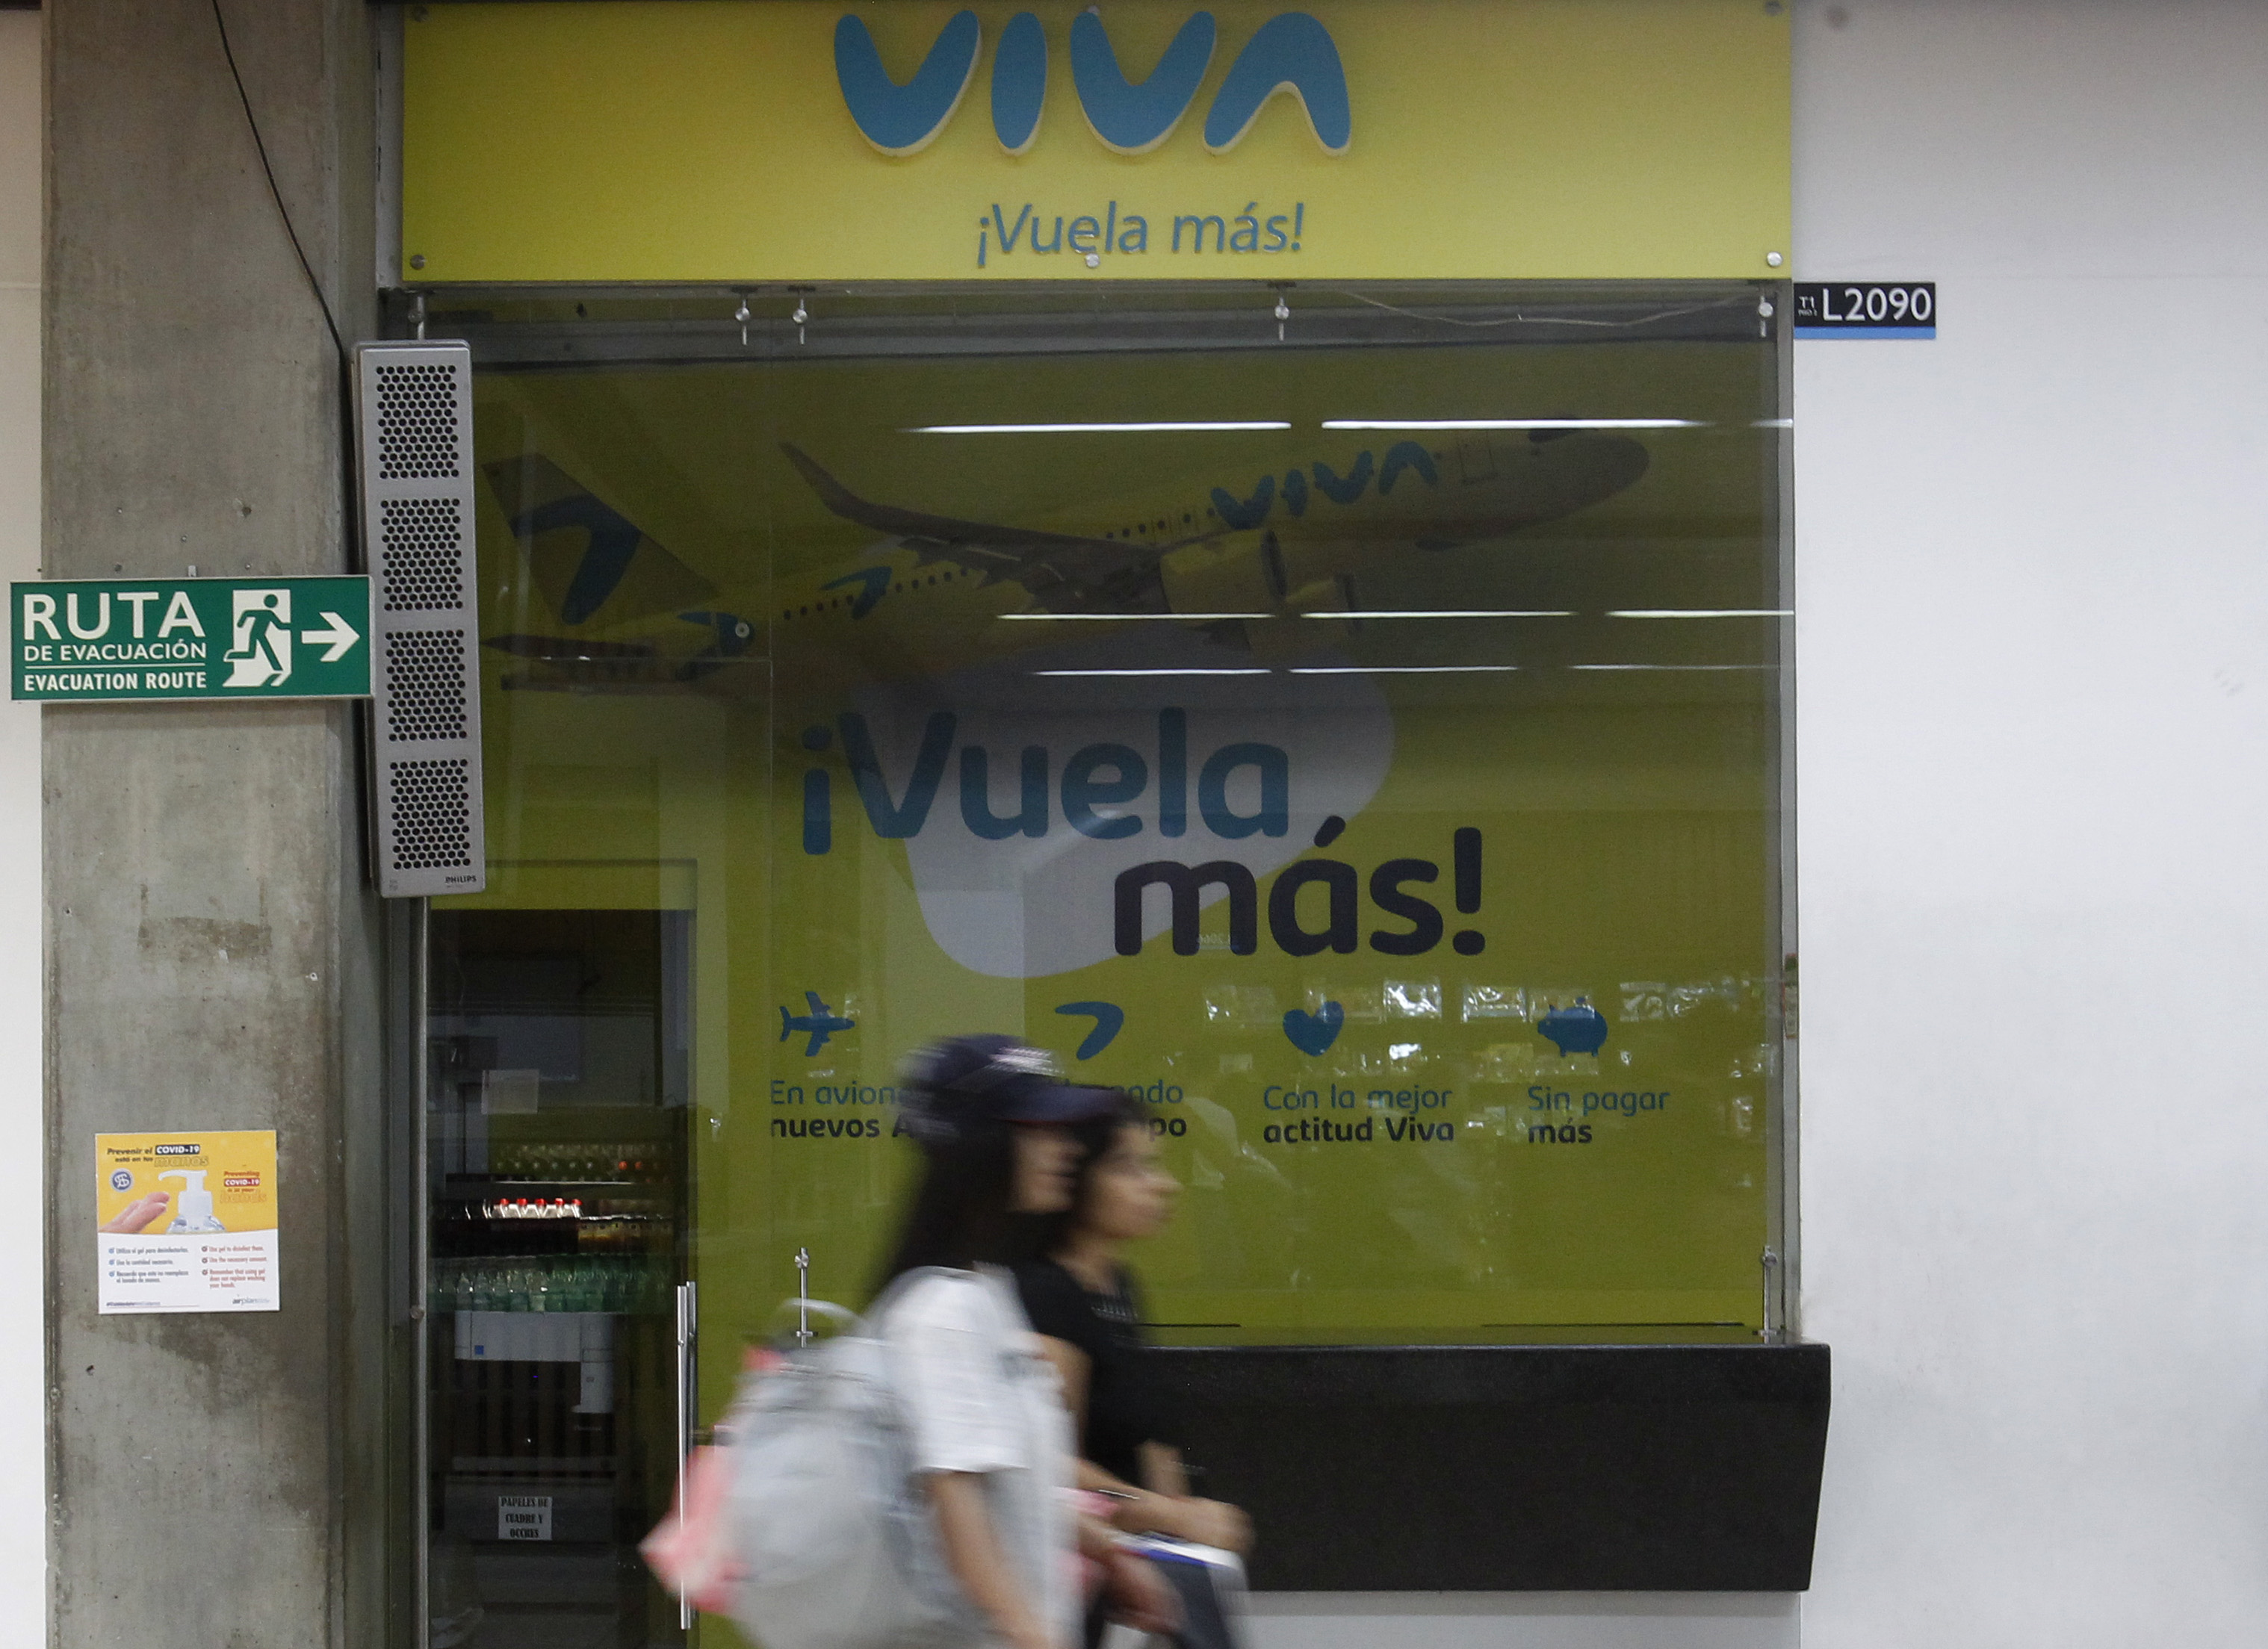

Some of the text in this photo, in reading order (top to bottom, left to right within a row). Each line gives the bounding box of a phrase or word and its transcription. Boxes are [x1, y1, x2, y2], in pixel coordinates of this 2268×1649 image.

[976, 201, 1304, 269] ¡Vuela más!
[1822, 287, 1933, 321] L2090
[23, 591, 206, 641] RUTA
[24, 639, 207, 662] DE EVACUACIÓN
[24, 671, 207, 692] EVACUATION ROUTE
[802, 707, 1289, 855] ¡Vuela
[1114, 815, 1486, 957] más!
[770, 1080, 899, 1105] En avion
[1263, 1084, 1454, 1115] Con la mejor
[1528, 1085, 1671, 1117] Sin pagar
[771, 1117, 881, 1138] nuevos
[1263, 1116, 1454, 1143] actitud Viva
[1528, 1117, 1593, 1144] más
[156, 1145, 200, 1154] COVID-19
